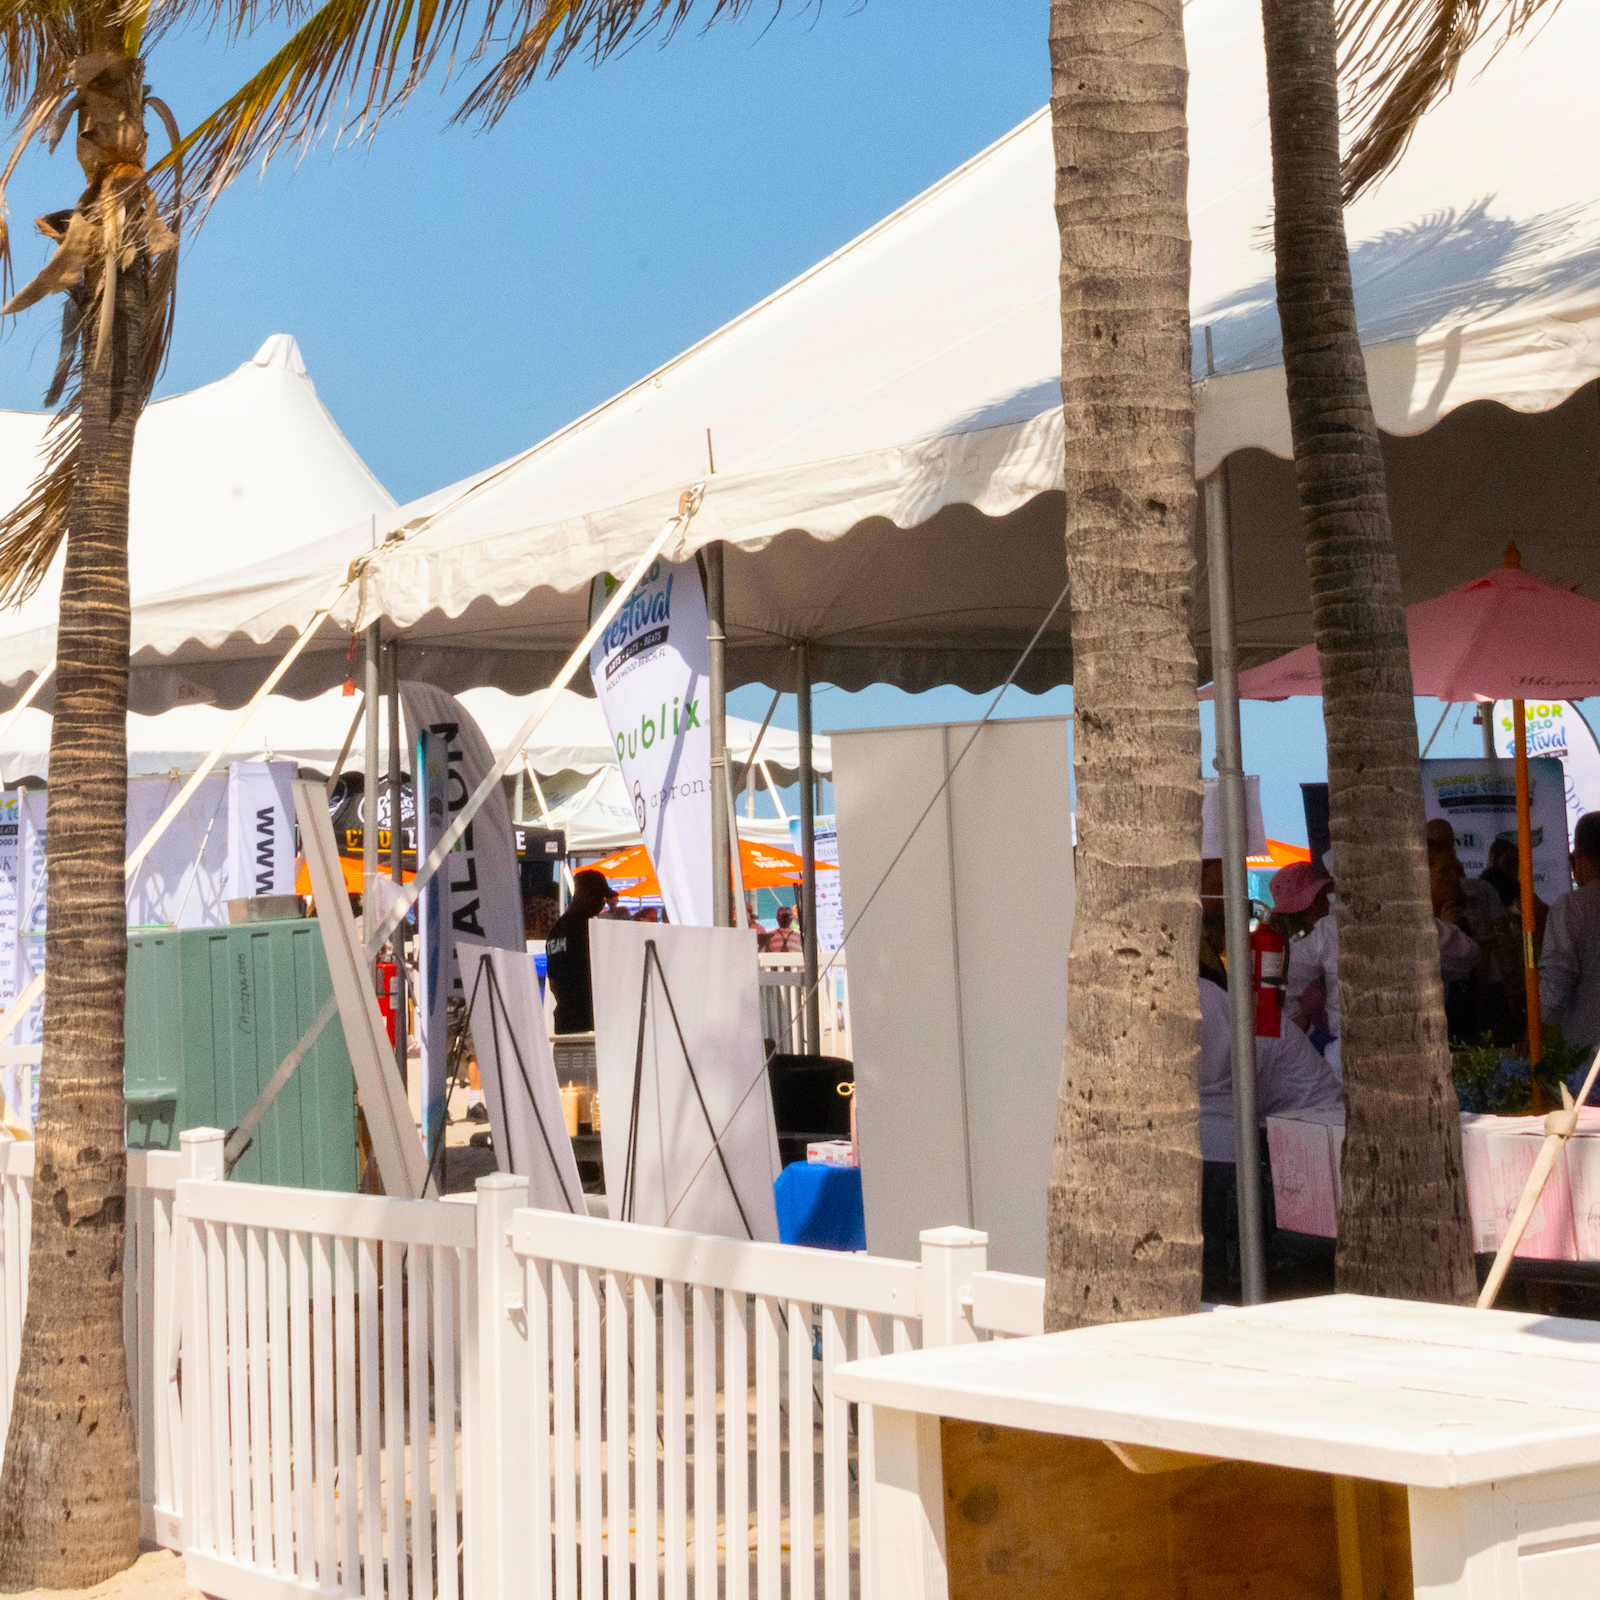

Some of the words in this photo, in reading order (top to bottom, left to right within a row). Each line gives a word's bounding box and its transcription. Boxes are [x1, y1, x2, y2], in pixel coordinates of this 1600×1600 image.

[606, 661, 638, 693] HOLLYWOOD
[1501, 703, 1562, 731] SVOR
[1506, 725, 1568, 757] Fstival
